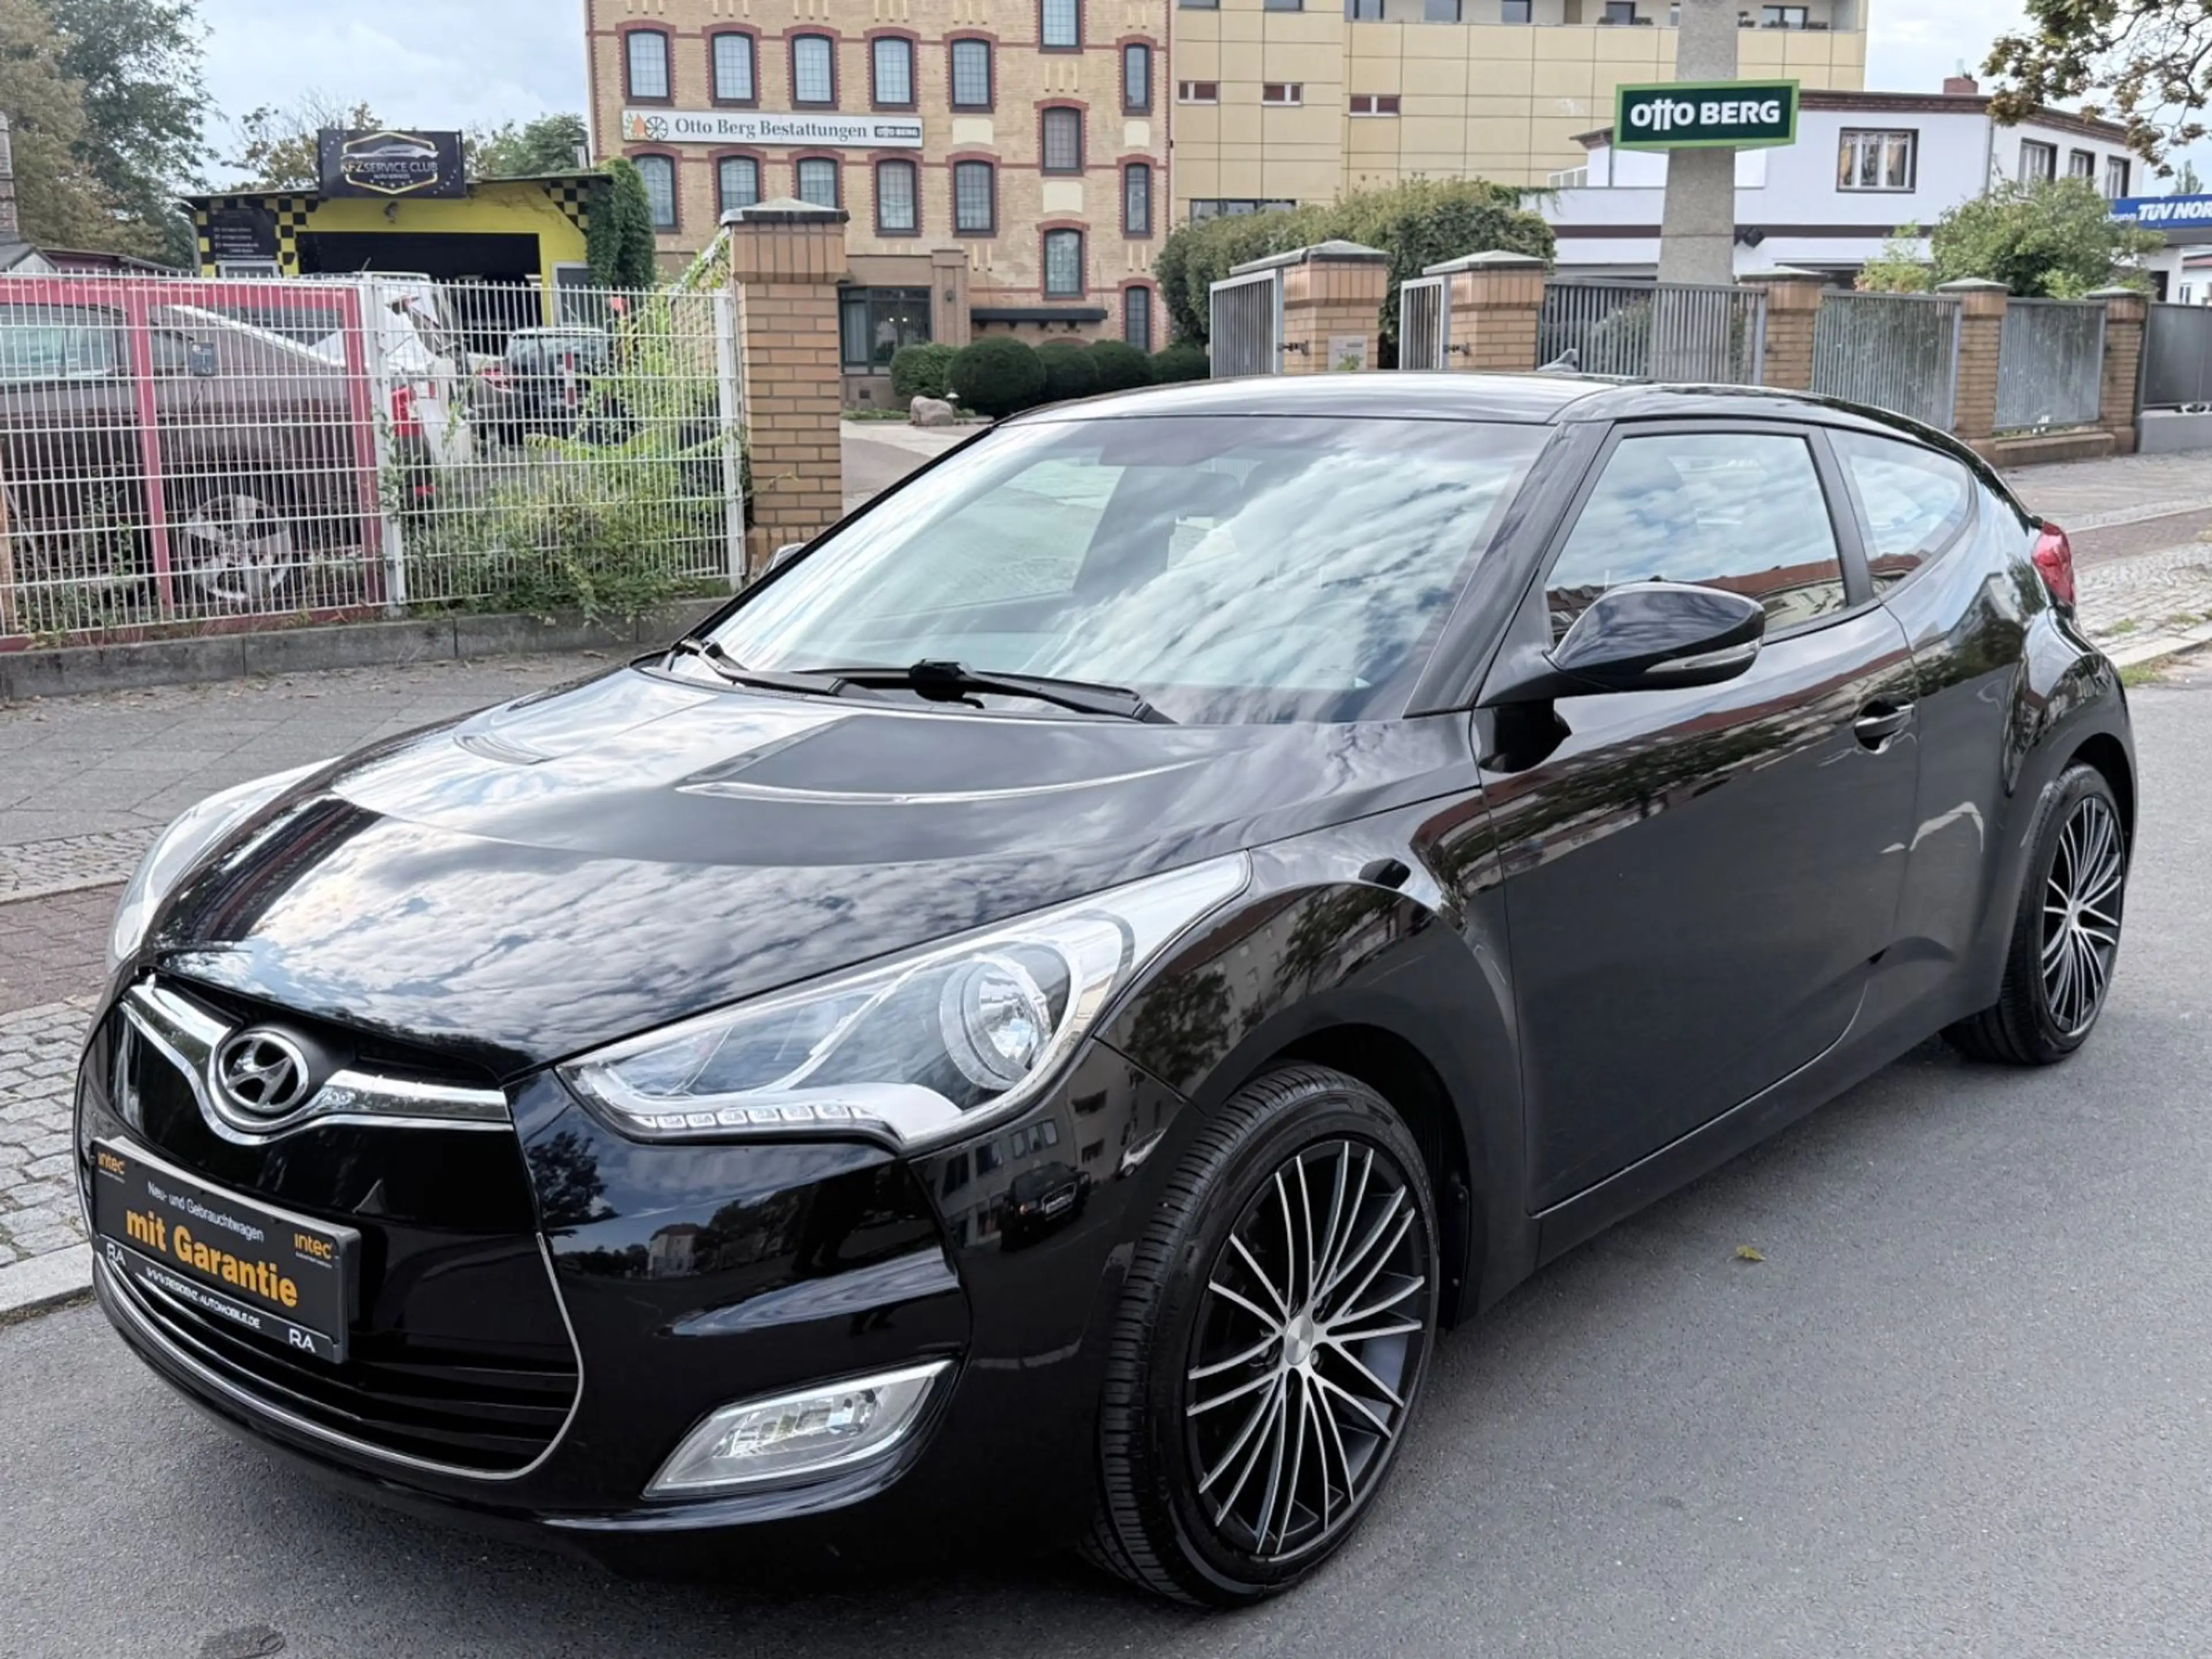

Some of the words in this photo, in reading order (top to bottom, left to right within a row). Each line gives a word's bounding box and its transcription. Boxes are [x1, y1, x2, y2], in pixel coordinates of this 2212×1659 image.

[1699, 100, 1781, 125] BERG
[675, 117, 713, 134] Otto
[717, 118, 756, 139] Berg
[760, 120, 868, 142] Bestattungen
[147, 1181, 168, 1202] Neu-
[169, 1194, 185, 1210] und
[186, 1198, 264, 1243] Gebrauchtwagen
[106, 1242, 127, 1266] RA
[126, 1210, 166, 1252] mit
[174, 1225, 298, 1308] Garantie
[294, 1233, 332, 1260] intec
[289, 1328, 316, 1353] RA
